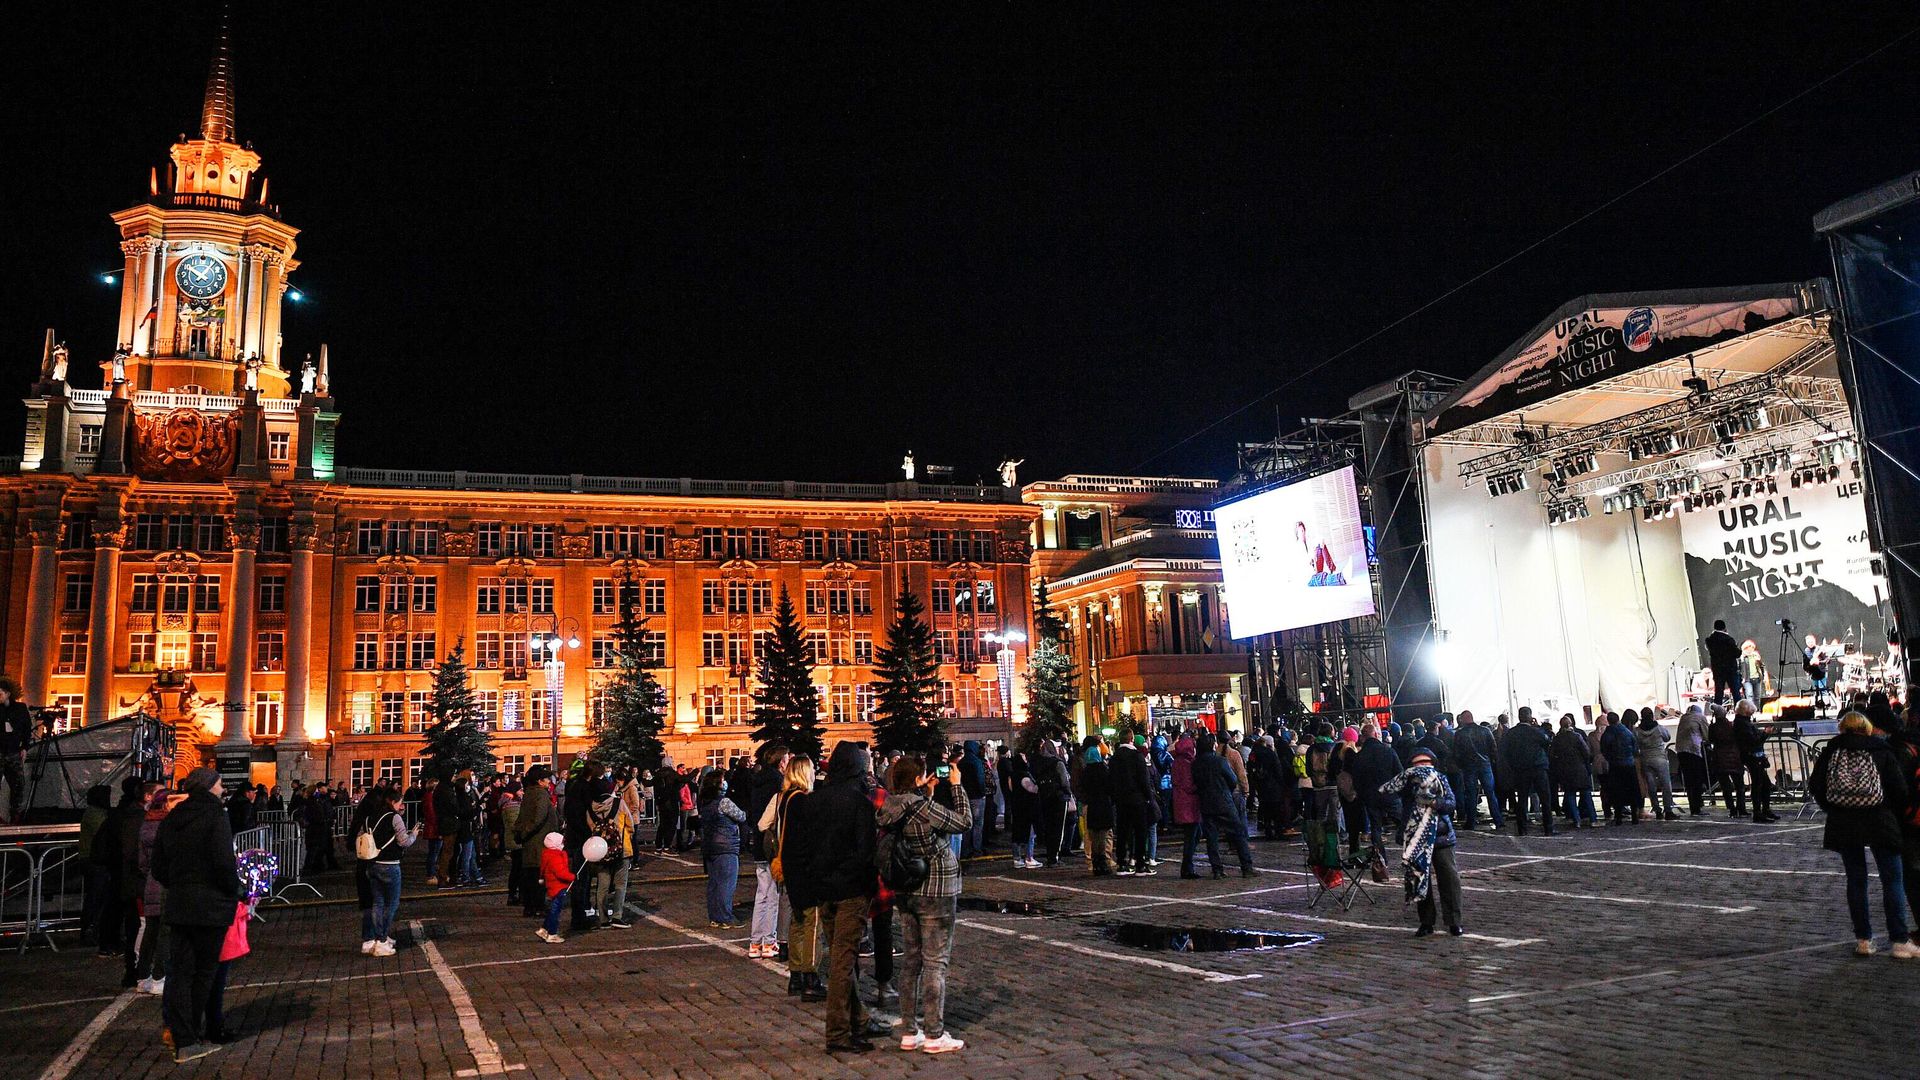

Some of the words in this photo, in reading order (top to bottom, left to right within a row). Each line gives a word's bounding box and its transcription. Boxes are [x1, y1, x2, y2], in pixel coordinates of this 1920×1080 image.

[1555, 309, 1605, 341] URAL
[1558, 328, 1615, 367] MUSIC
[1560, 348, 1617, 387] NIGHT
[1718, 496, 1802, 532] URAL
[1723, 525, 1822, 576] MUSIC
[1727, 558, 1824, 607] NIGHT
